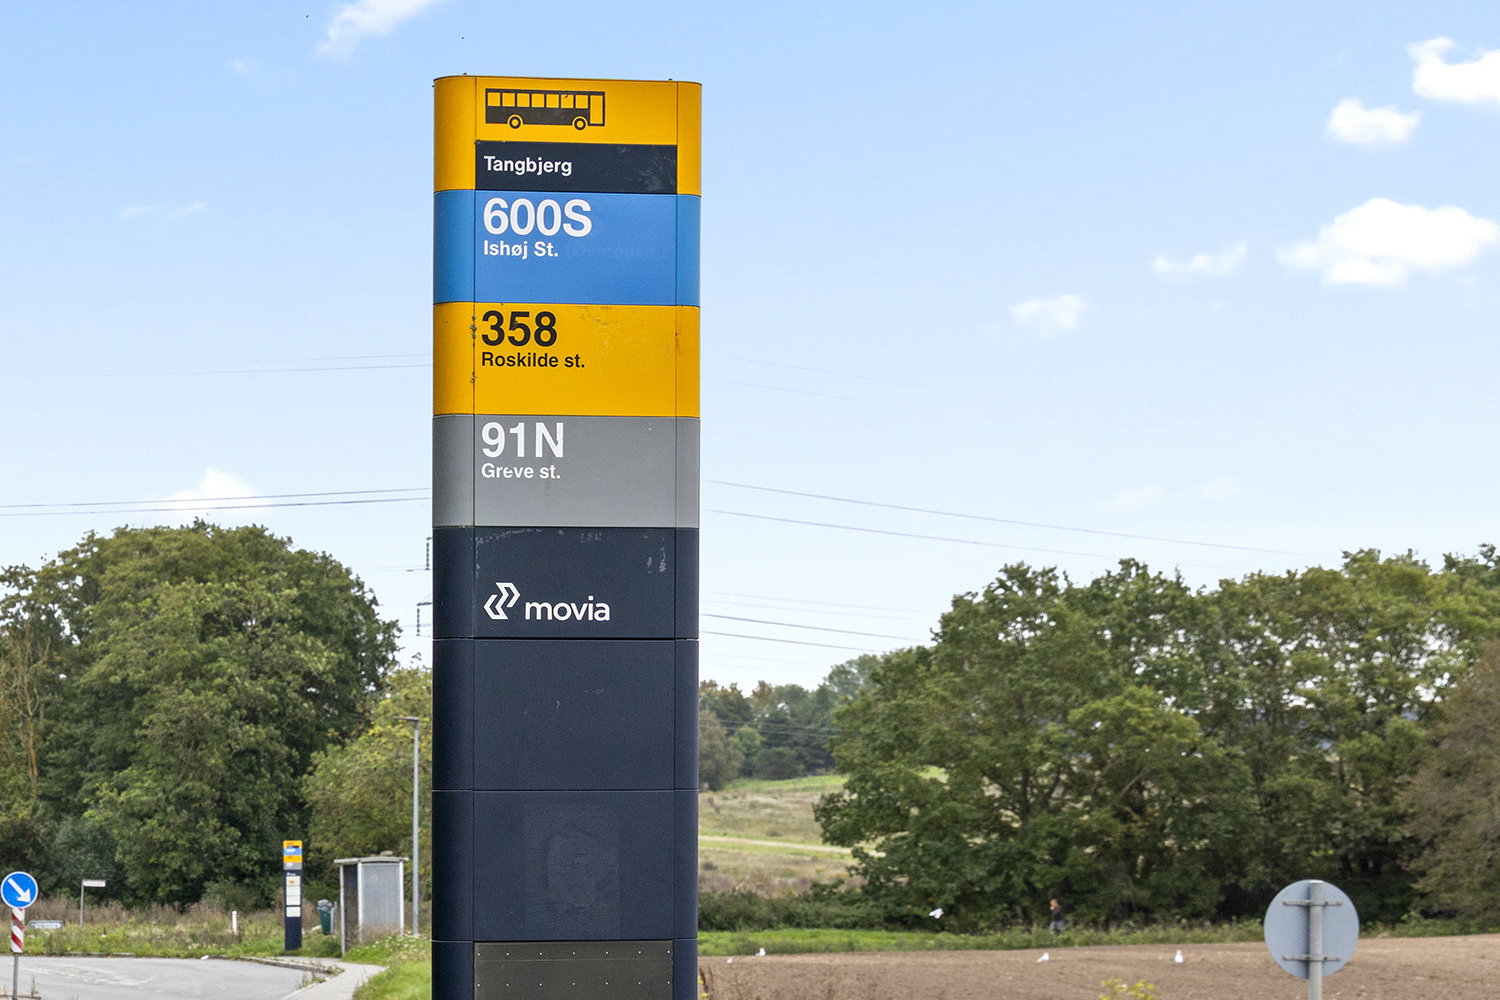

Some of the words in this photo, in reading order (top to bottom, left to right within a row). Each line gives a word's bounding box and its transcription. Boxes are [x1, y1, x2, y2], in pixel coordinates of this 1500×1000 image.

[483, 155, 572, 176] Tangbjerg
[483, 197, 593, 237] 600S
[483, 240, 528, 260] Ishøj
[533, 241, 559, 257] St.
[481, 310, 557, 347] 358
[481, 351, 559, 368] Roskilde
[564, 353, 586, 368] st.
[481, 421, 564, 458] 91N
[481, 463, 534, 479] Greve
[539, 464, 561, 480] st.
[524, 595, 611, 622] movia
